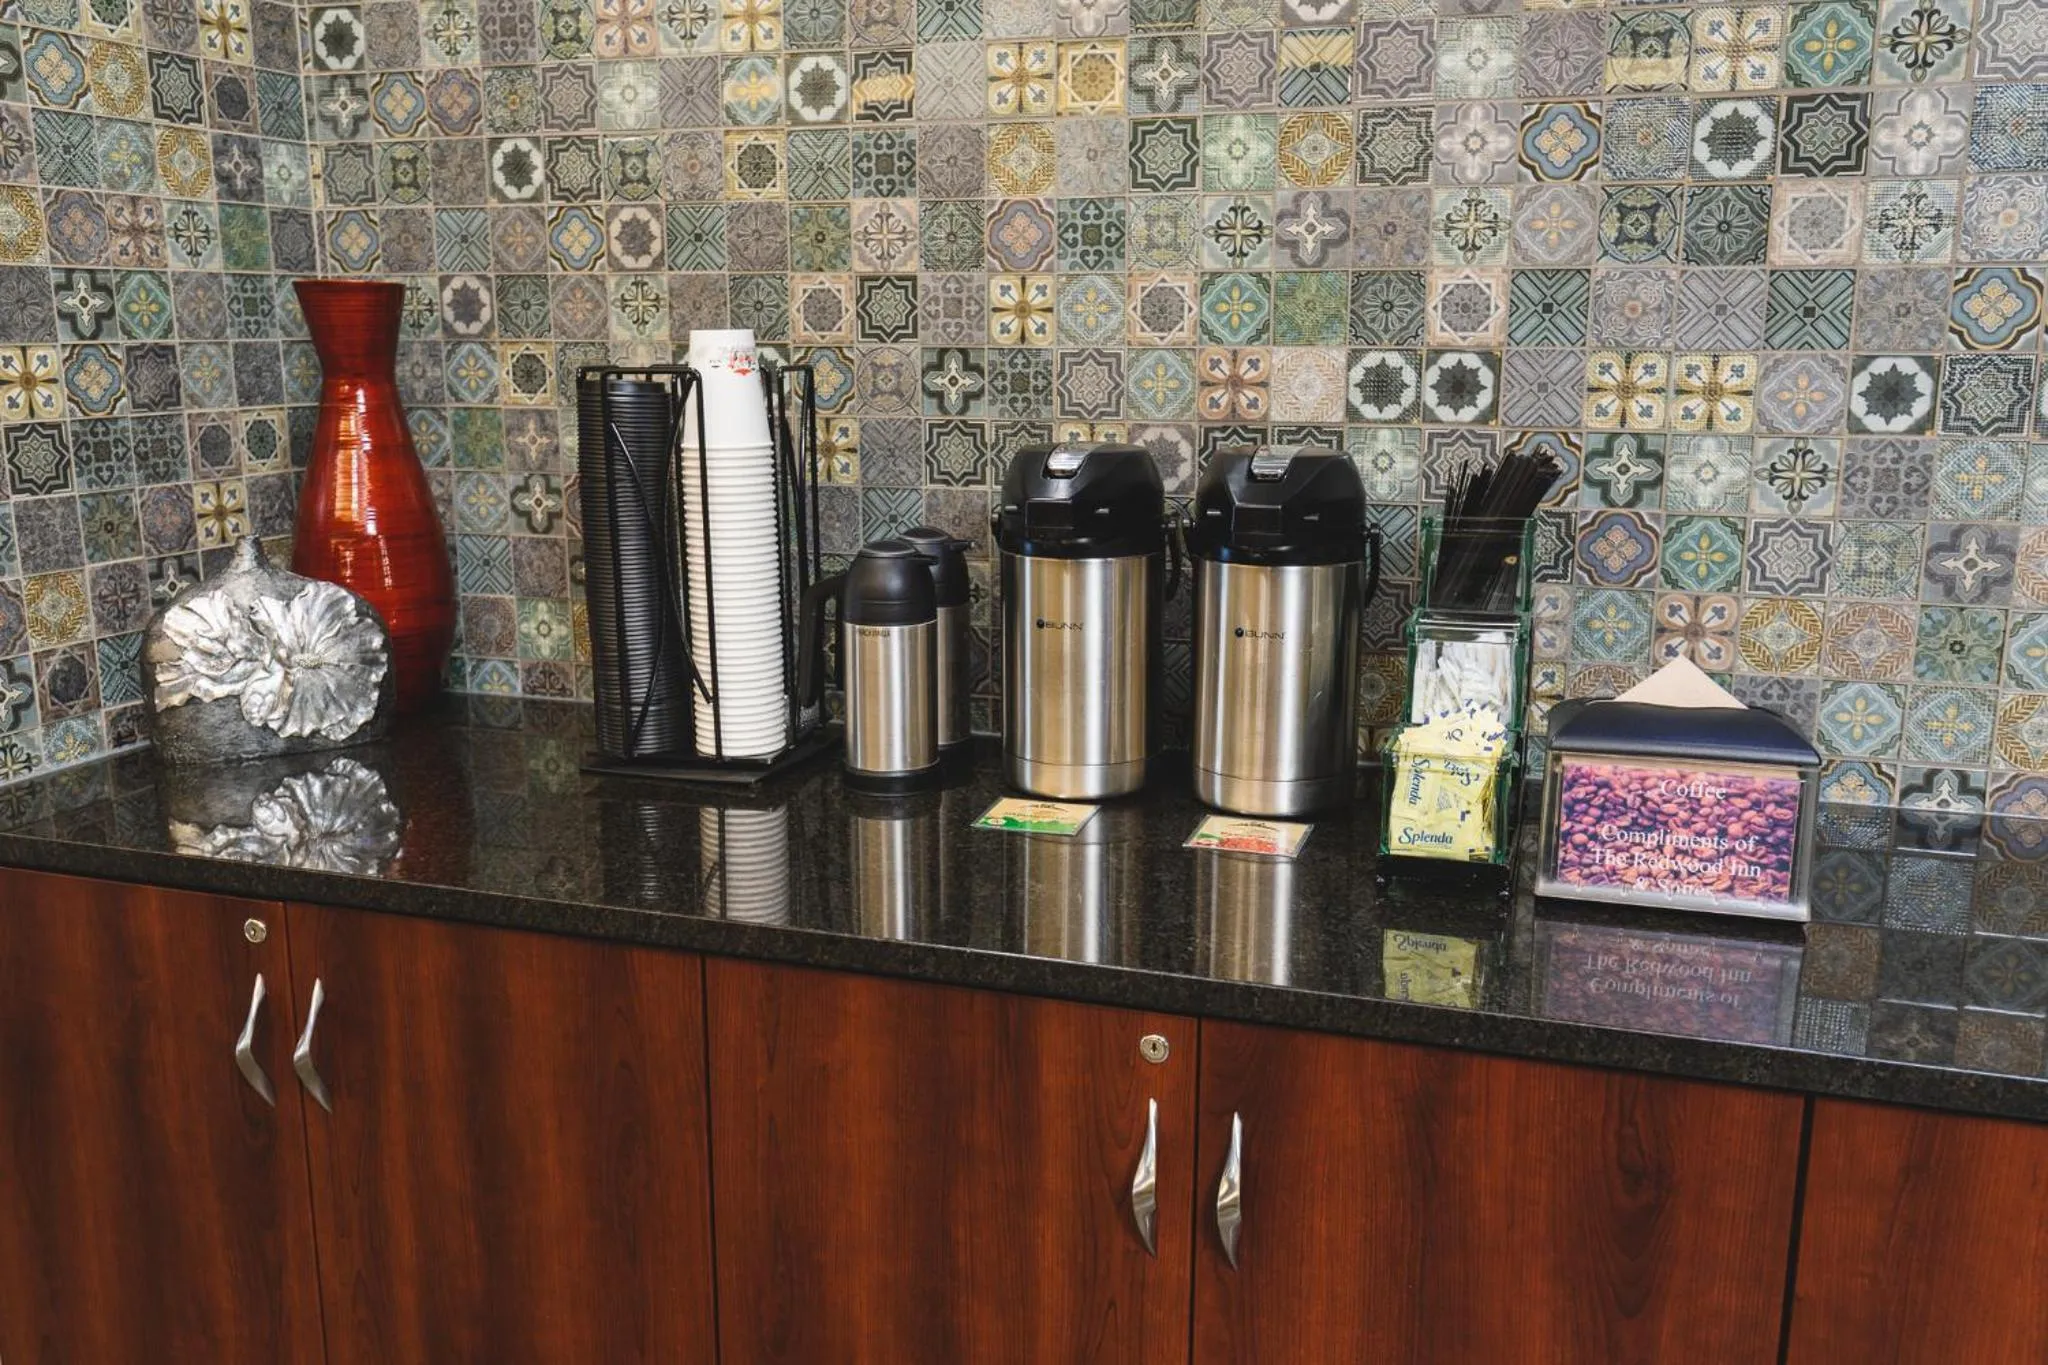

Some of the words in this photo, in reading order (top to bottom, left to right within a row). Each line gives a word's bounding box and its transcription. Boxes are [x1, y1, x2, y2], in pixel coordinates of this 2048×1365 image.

[1244, 630, 1285, 640] BUNN
[1408, 754, 1431, 806] Splenda
[1660, 778, 1727, 800] Coffee
[1398, 826, 1454, 845] Splenda
[1601, 824, 1729, 850] Compliments
[1734, 835, 1759, 852] of
[1591, 848, 1628, 867] The
[1633, 853, 1723, 874] Redwood
[1728, 860, 1762, 878] Inn
